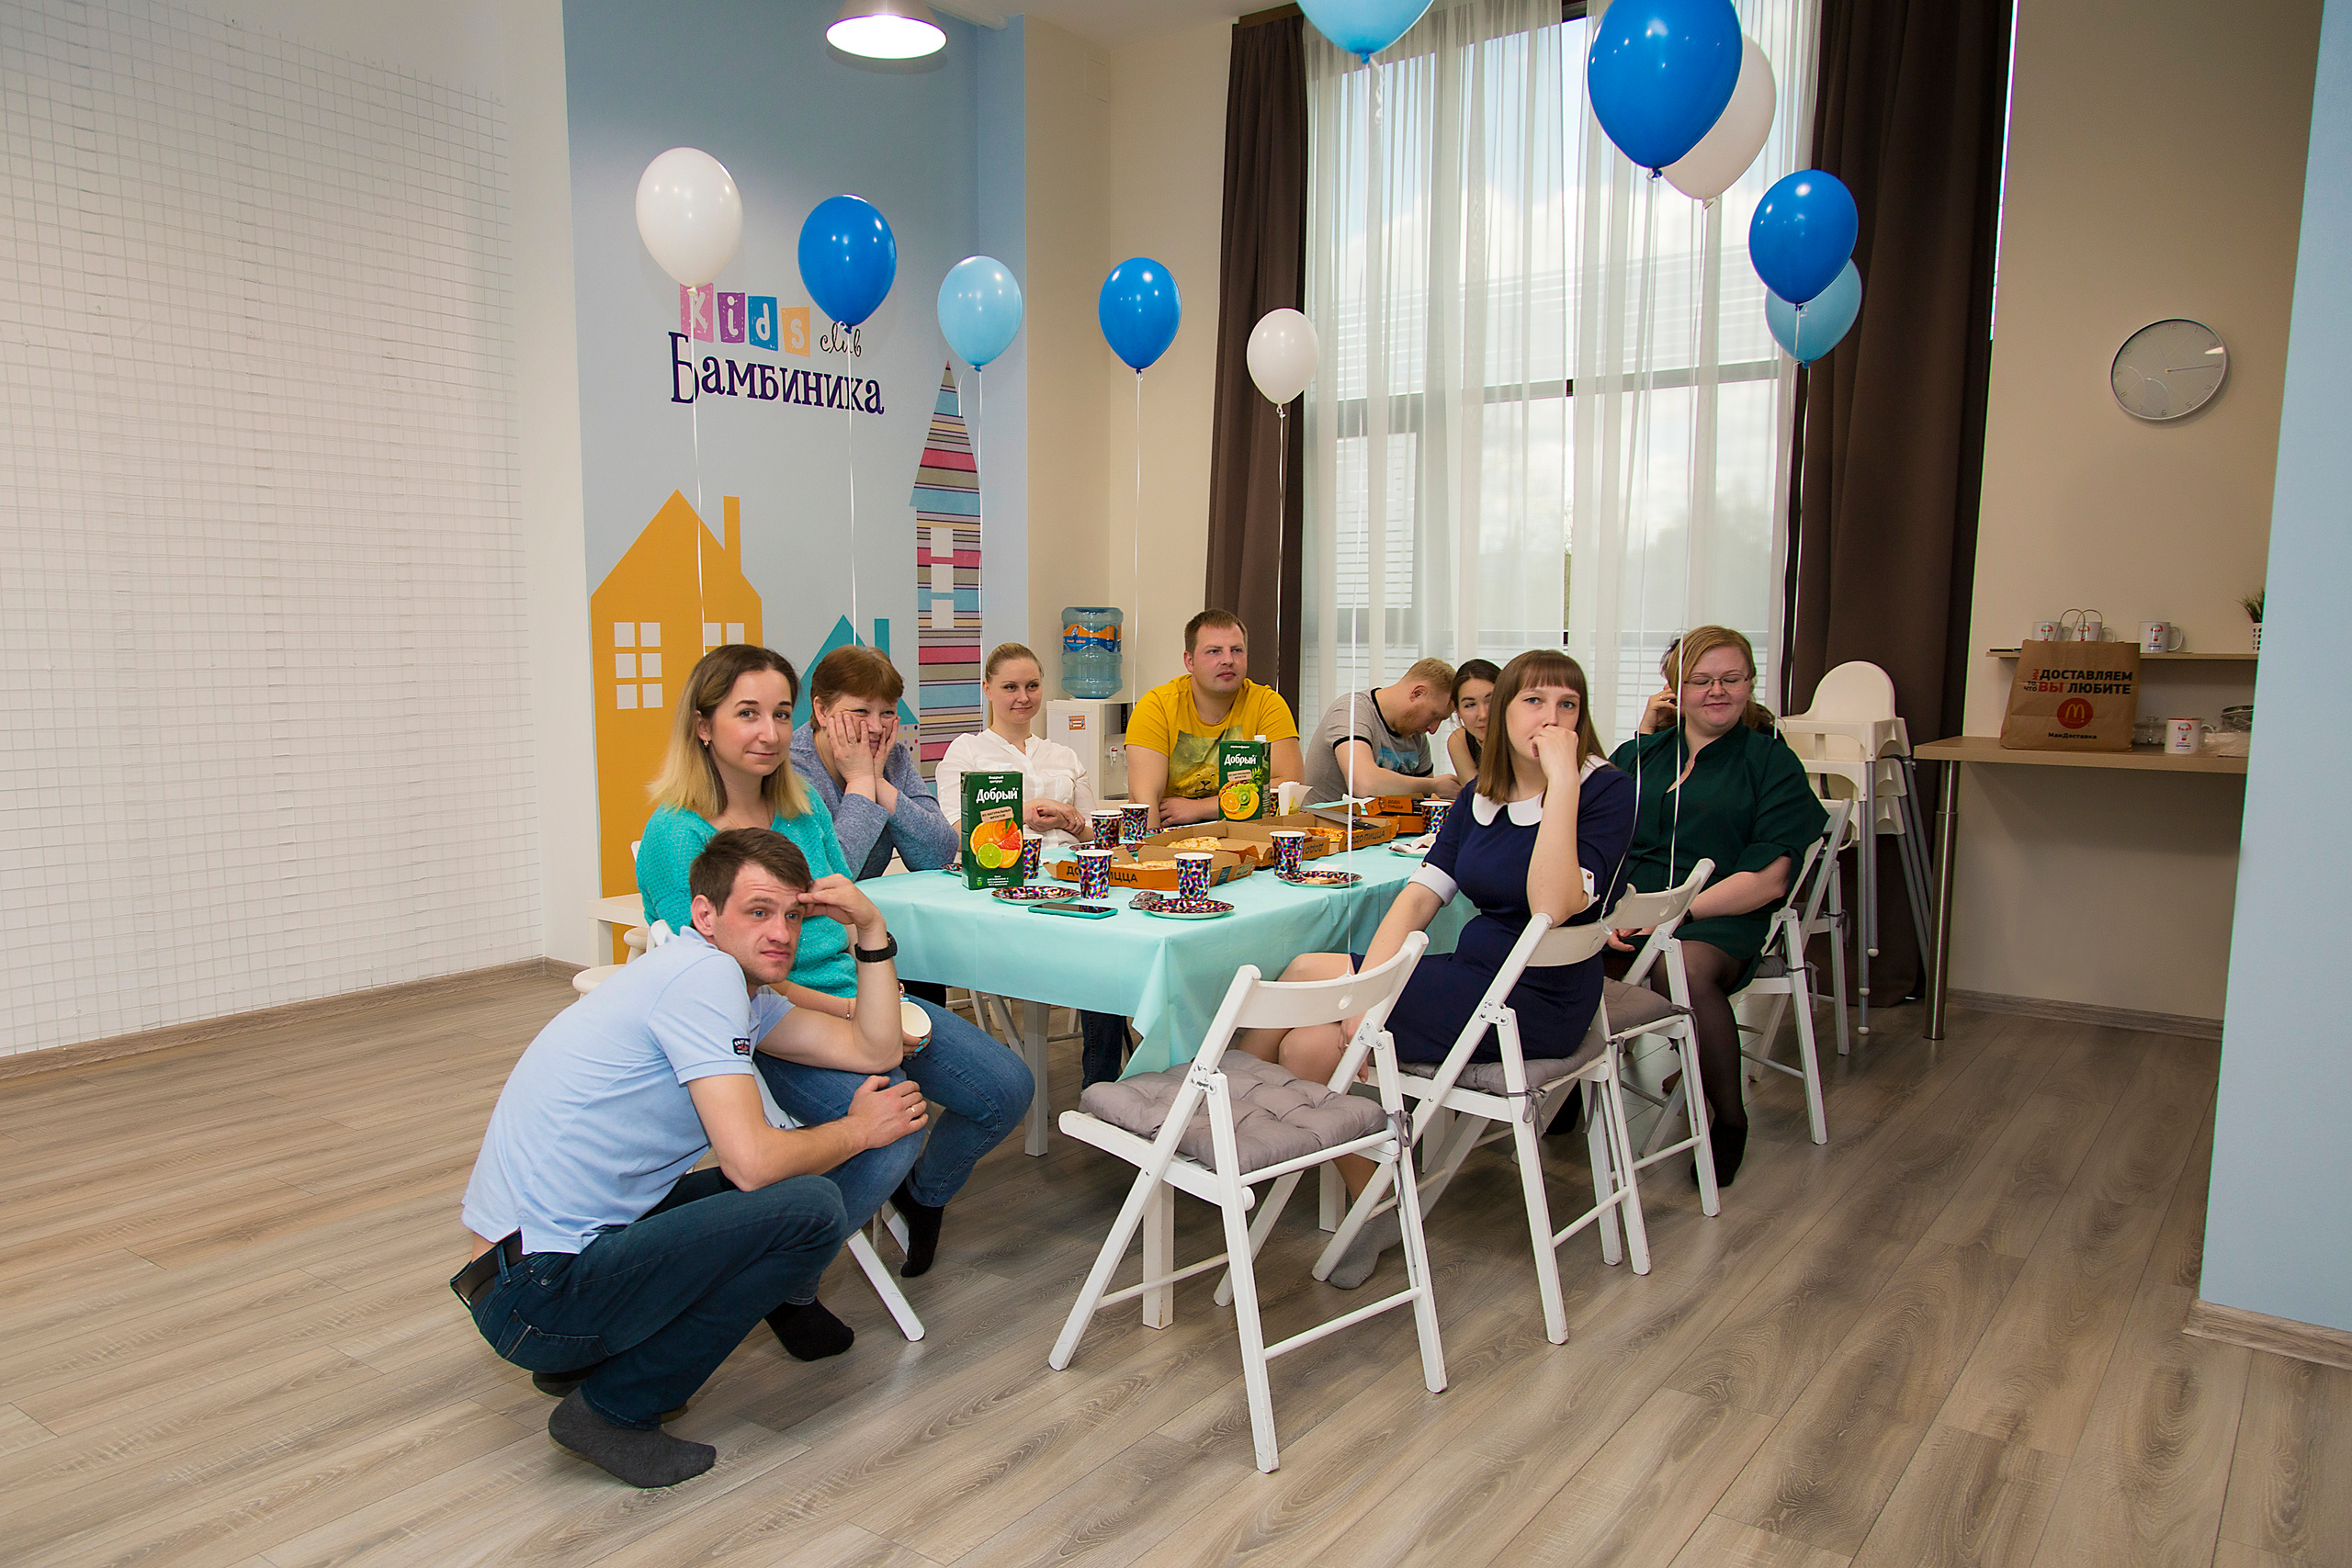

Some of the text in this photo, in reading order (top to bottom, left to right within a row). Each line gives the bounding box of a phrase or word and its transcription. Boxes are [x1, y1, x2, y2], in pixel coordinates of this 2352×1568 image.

[668, 332, 885, 414] Бамбиника
[2040, 669, 2133, 682] ДОСТАВЛЯЕМ
[2039, 682, 2132, 694] ВЫ ЛЮБИТЕ
[1224, 753, 1257, 766] Добрый
[976, 786, 1018, 804] Добрый
[1109, 871, 1138, 884] ИЦЦА
